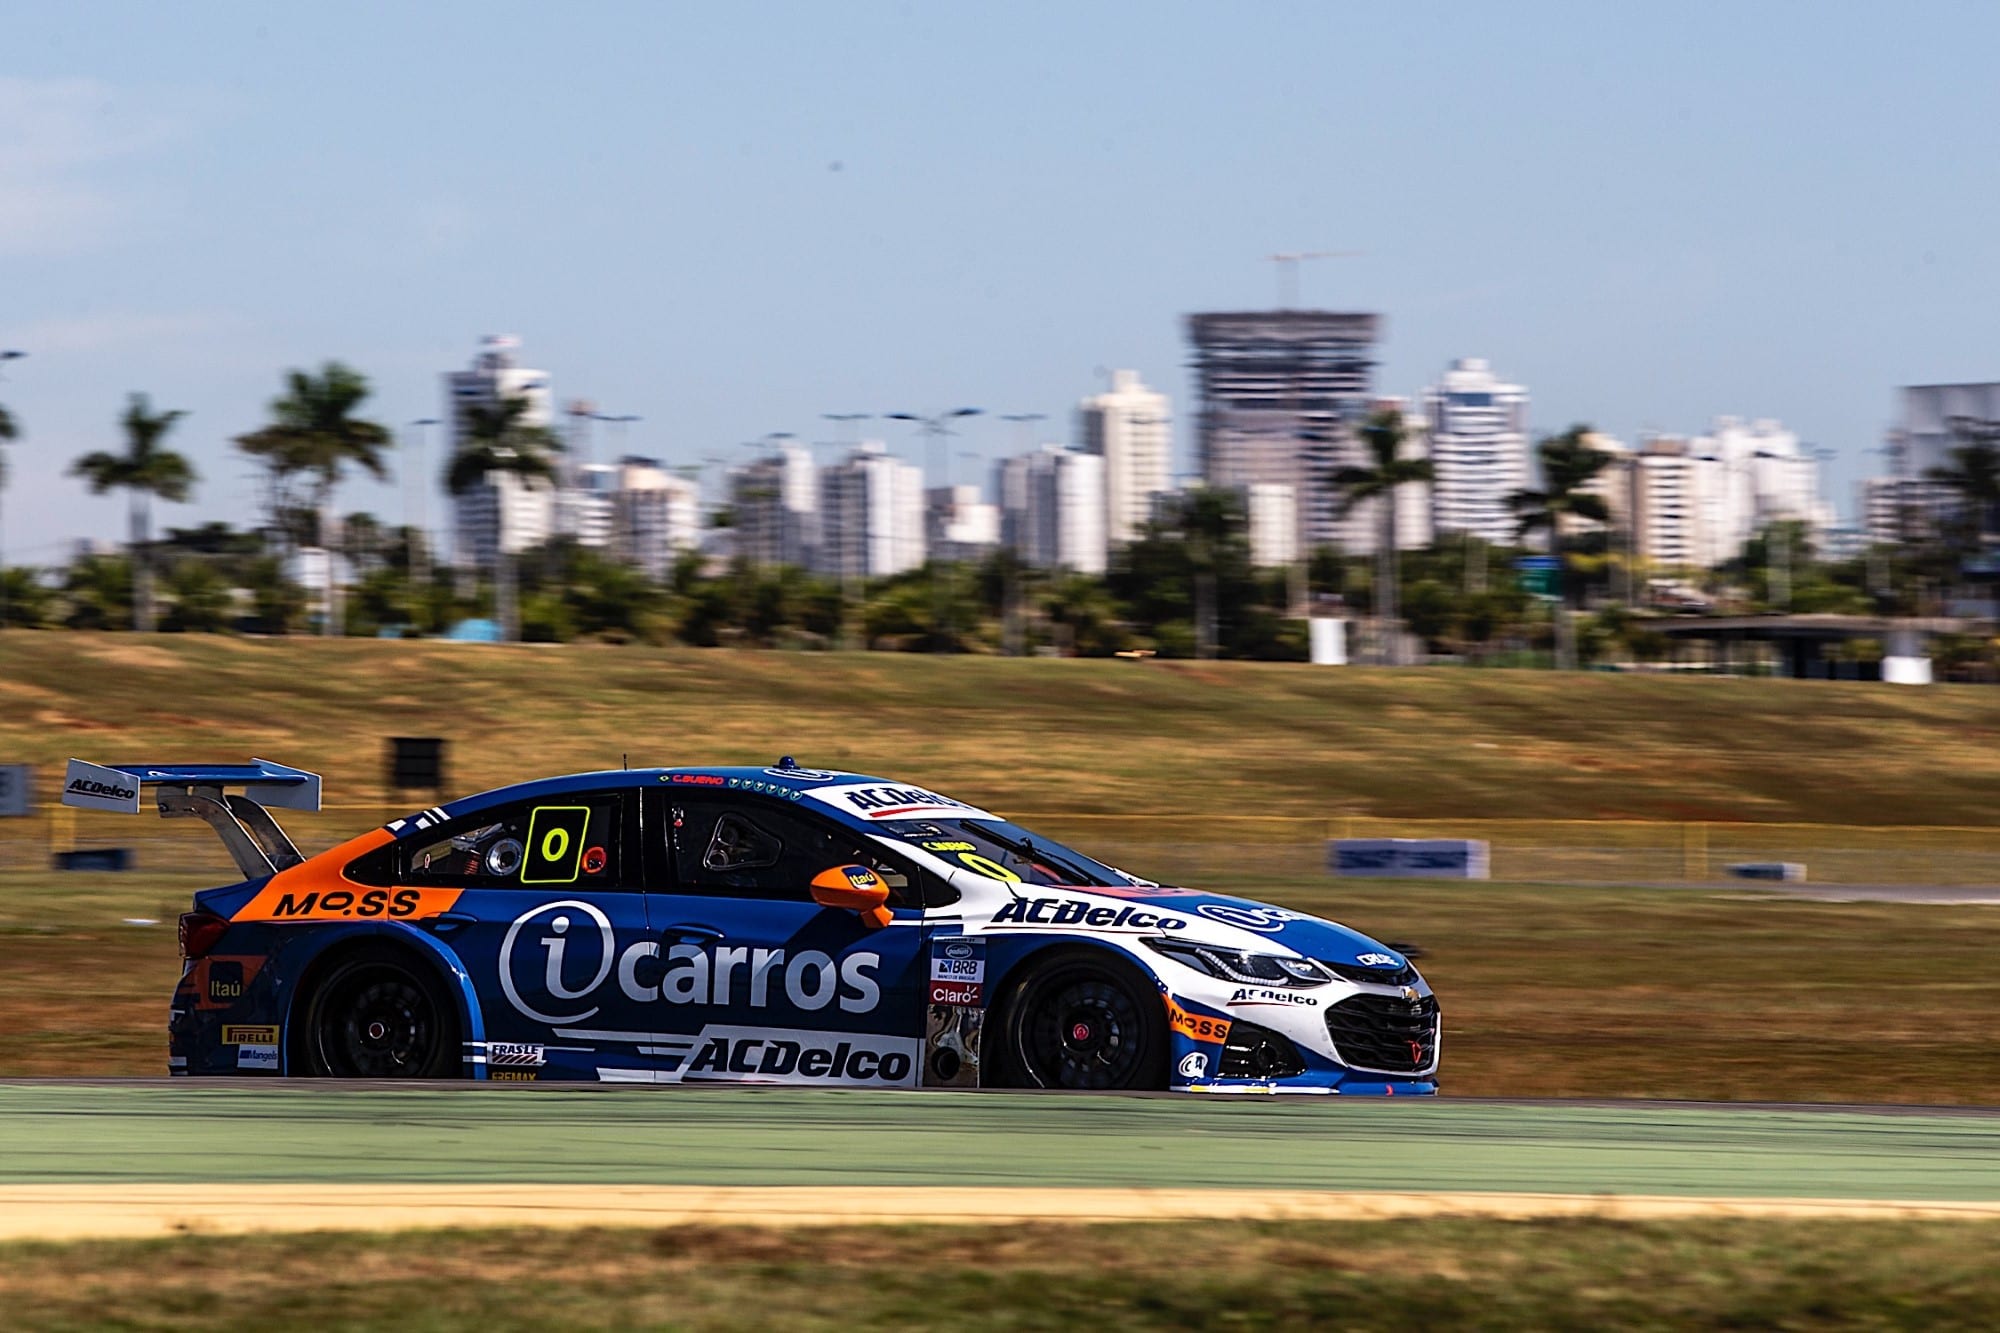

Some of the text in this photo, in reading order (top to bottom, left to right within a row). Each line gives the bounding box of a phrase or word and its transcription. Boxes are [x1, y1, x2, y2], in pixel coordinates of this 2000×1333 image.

[69, 779, 135, 799] ACDelco
[541, 828, 569, 861] 0
[958, 852, 1022, 883] 0
[849, 872, 875, 886] Itaú
[991, 897, 1187, 929] ACDelco
[952, 960, 977, 974] BRB
[211, 980, 241, 997] Itaú
[933, 988, 972, 1003] Claro
[226, 1027, 275, 1043] PIRELLI
[492, 1044, 538, 1055] FRASLE
[688, 1037, 911, 1081] ACDelco
